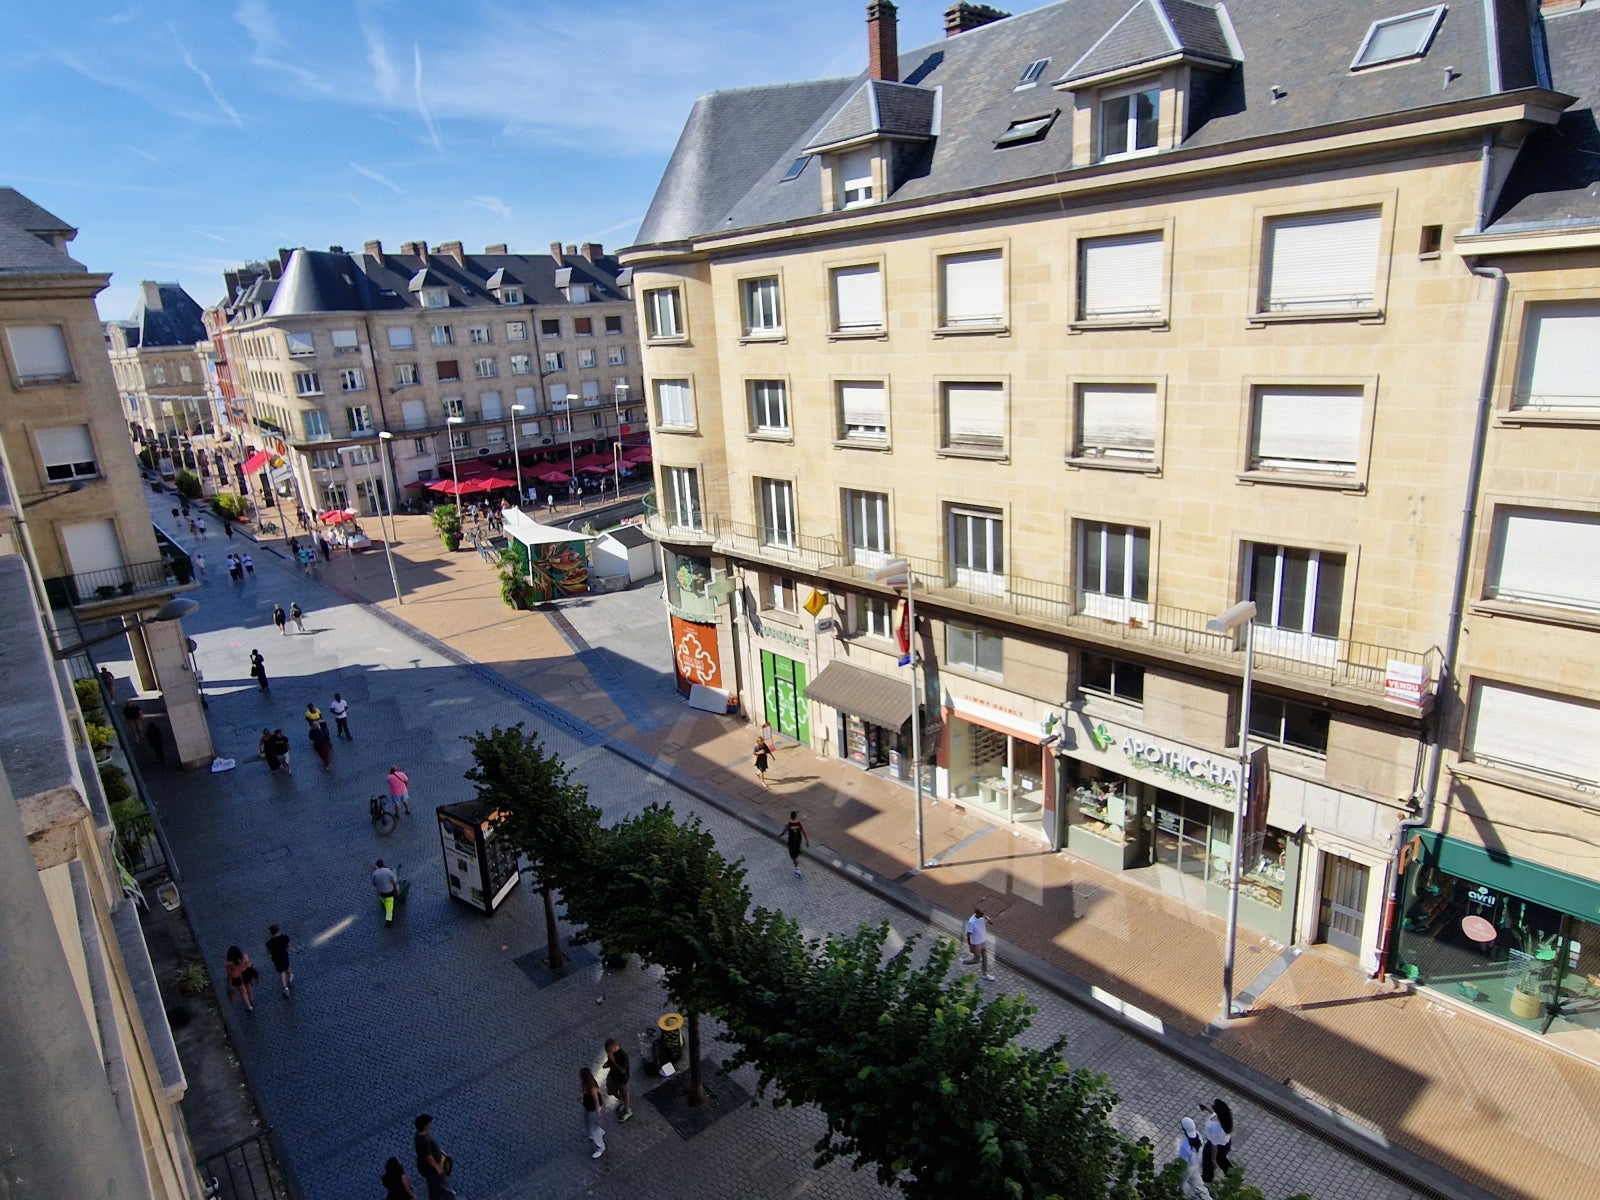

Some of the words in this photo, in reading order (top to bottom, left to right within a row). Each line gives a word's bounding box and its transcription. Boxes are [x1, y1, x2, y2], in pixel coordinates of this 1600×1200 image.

[1388, 680, 1419, 692] VENDU
[1122, 737, 1249, 791] APOTHIC'HA
[1468, 891, 1496, 905] avril
